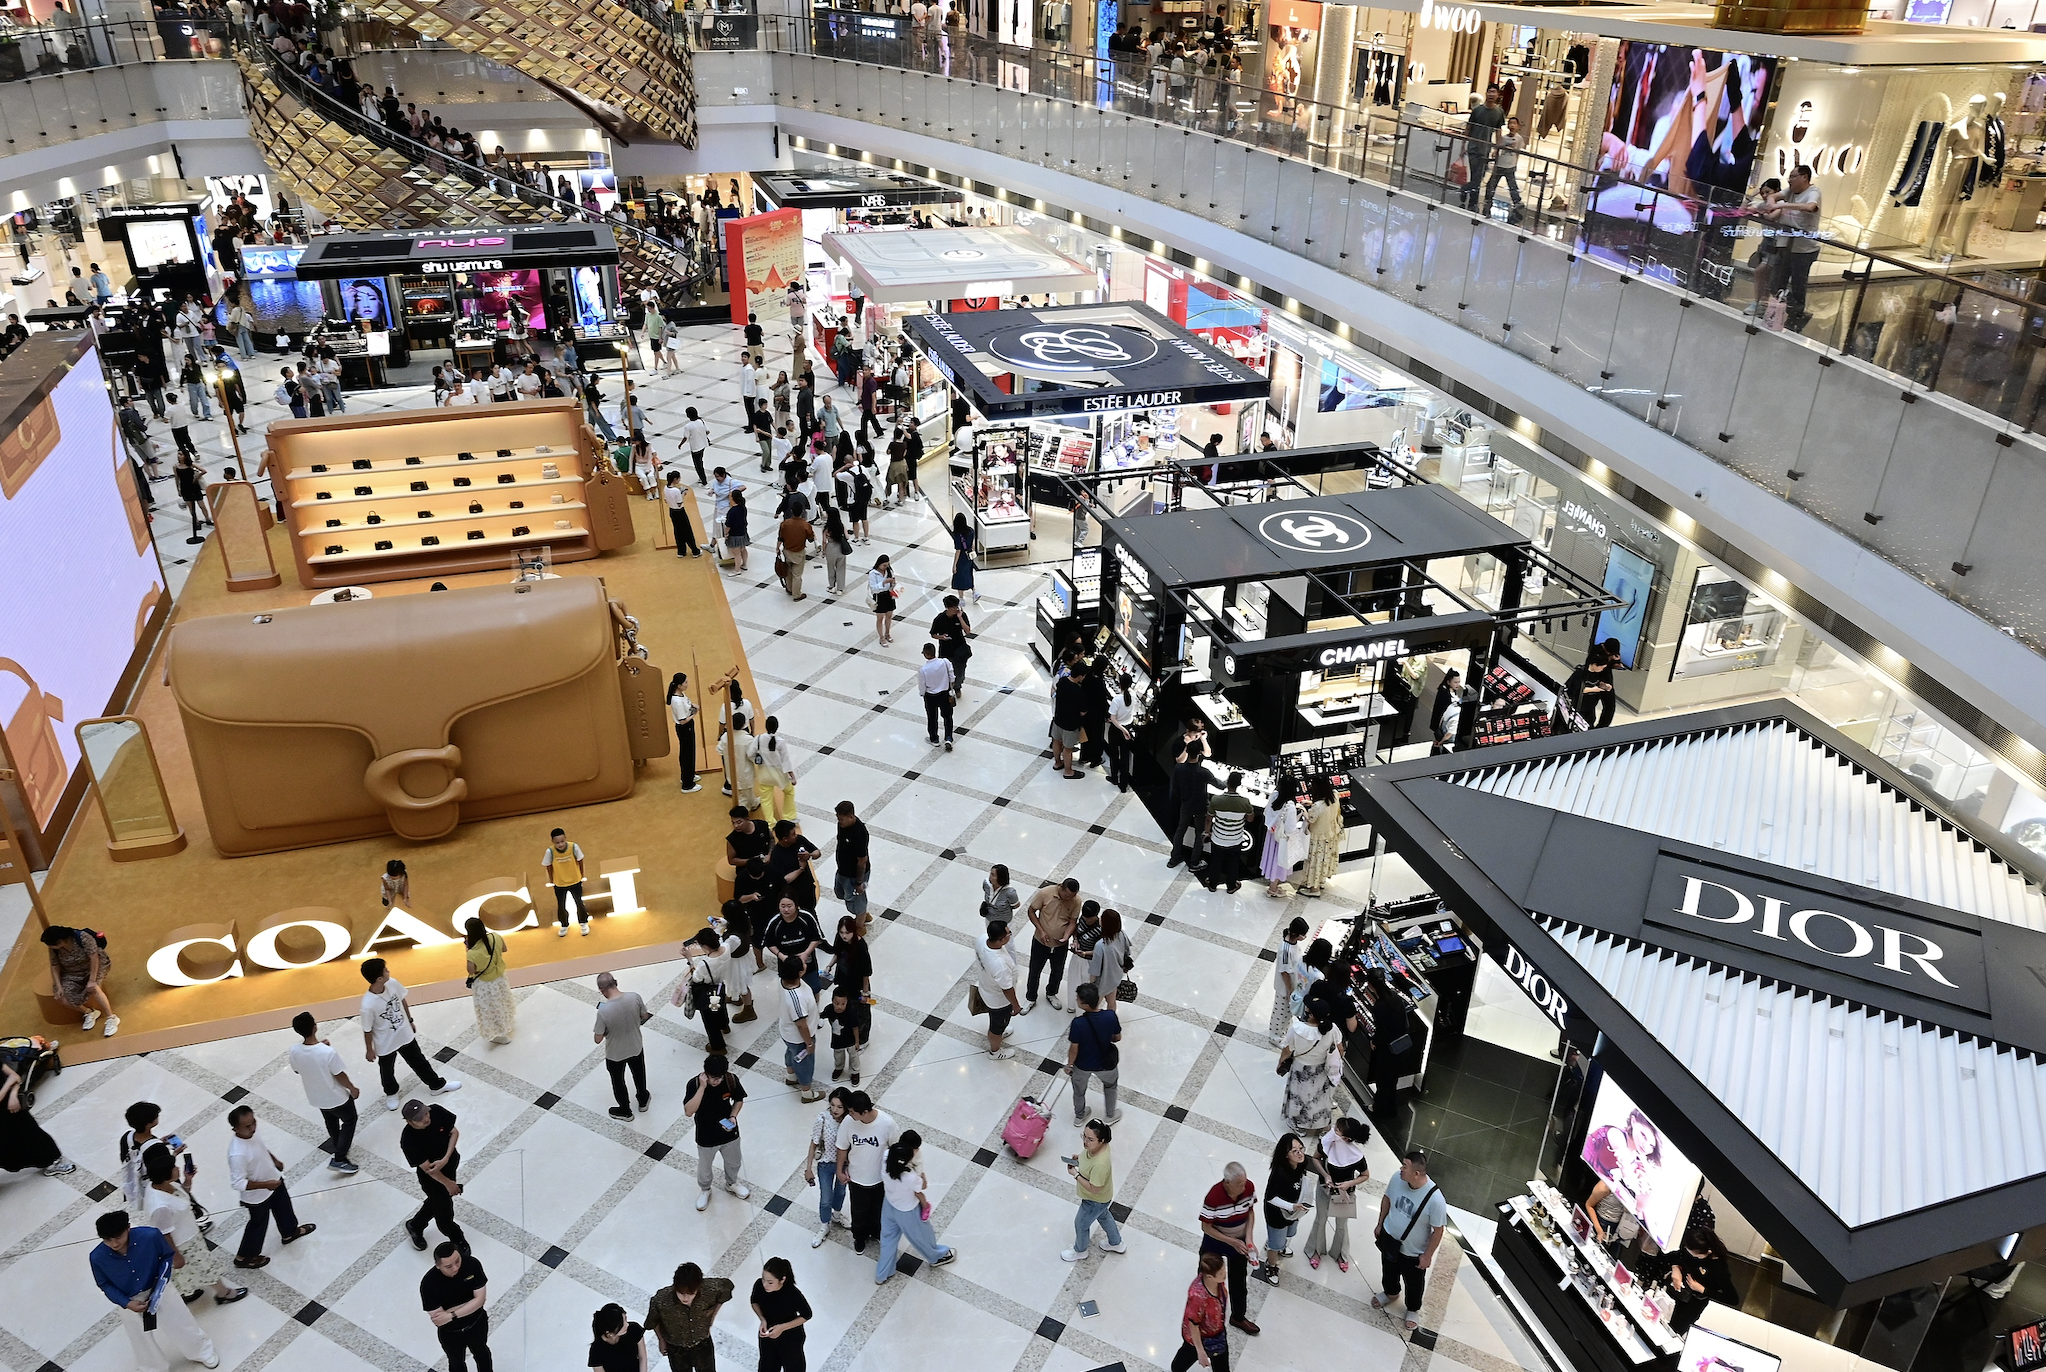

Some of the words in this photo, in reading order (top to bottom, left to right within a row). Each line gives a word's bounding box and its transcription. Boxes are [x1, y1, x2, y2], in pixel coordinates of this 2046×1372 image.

[861, 195, 886, 207] NARS
[421, 260, 449, 273] shu
[449, 258, 503, 271] uemura
[1127, 391, 1182, 408] LAUDER
[1115, 543, 1150, 589] CHANEL
[1320, 639, 1410, 666] CHANEL
[637, 690, 649, 739] COACH
[146, 867, 648, 987] COACH
[1672, 874, 1960, 989] DIOR
[1503, 943, 1568, 1030] DIOR
